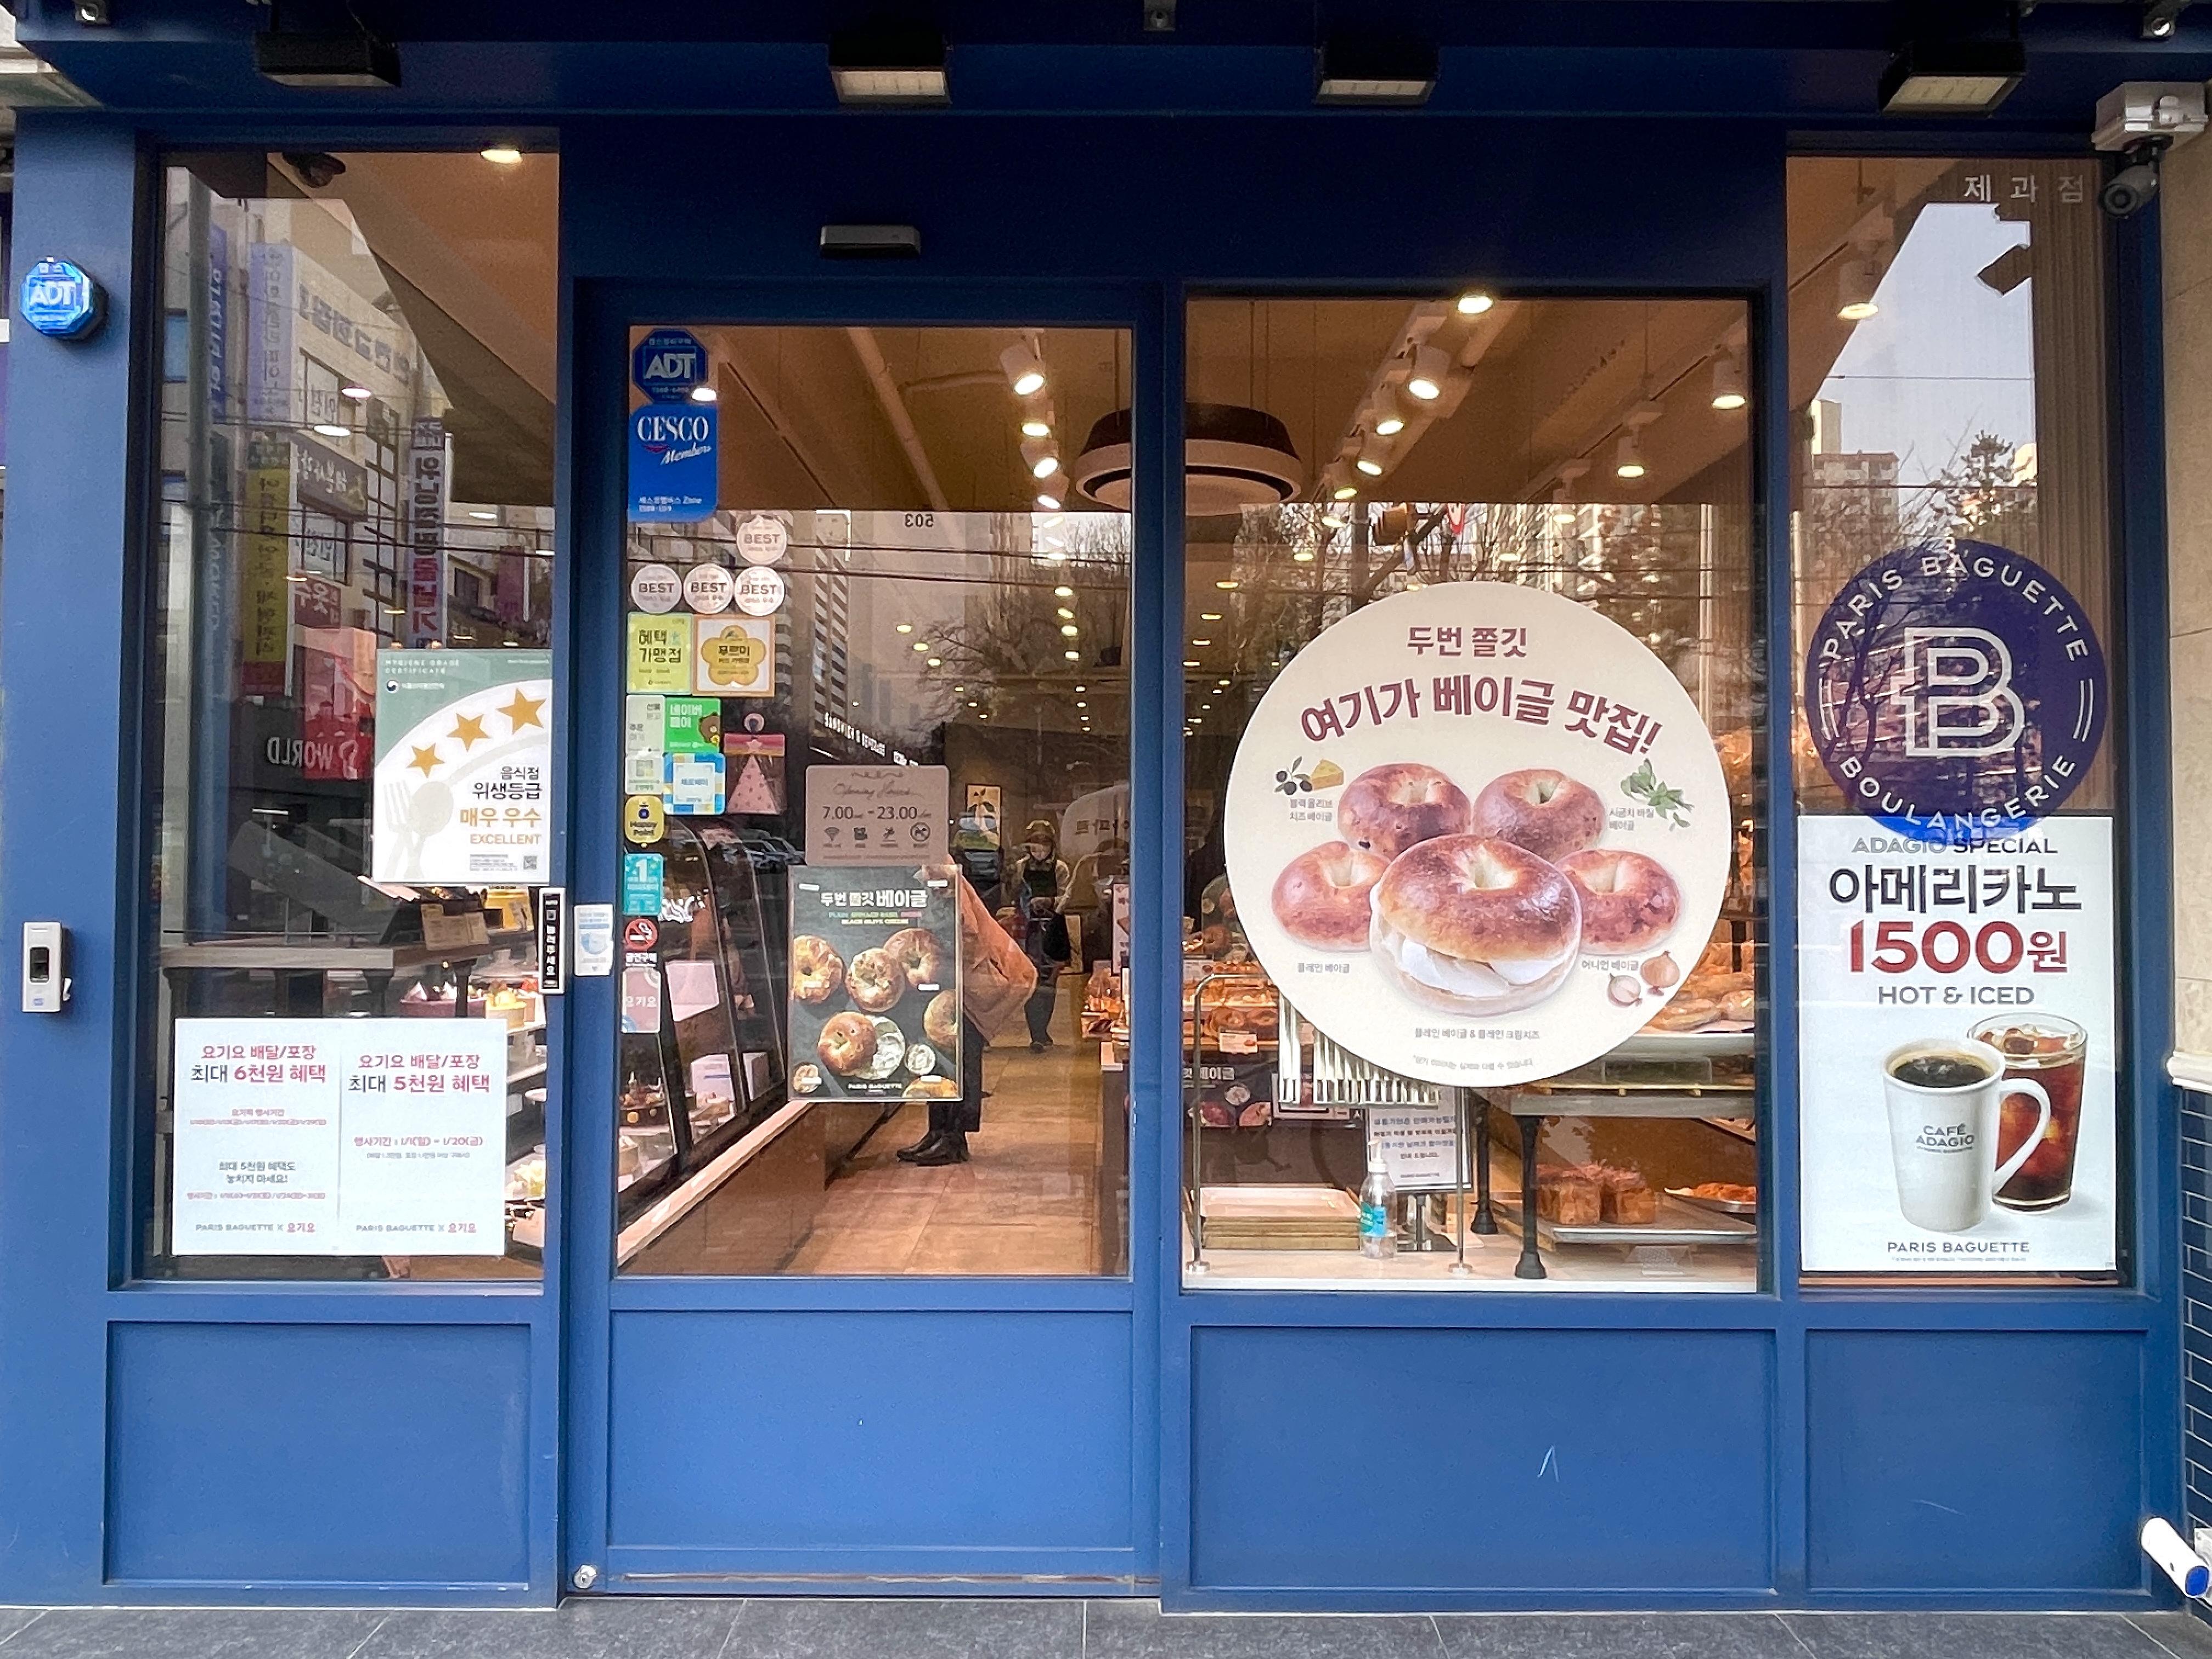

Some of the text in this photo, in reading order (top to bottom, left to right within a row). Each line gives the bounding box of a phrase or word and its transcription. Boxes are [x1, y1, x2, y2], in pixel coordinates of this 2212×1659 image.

[1963, 174, 2084, 203] 제과점
[30, 281, 76, 306] ADT
[644, 353, 696, 379] ADT
[637, 416, 709, 441] CESCO
[744, 534, 780, 544] BEST
[639, 583, 675, 593] BEST
[690, 582, 727, 592] BEST
[741, 585, 777, 595] BEST
[1823, 569, 1902, 661] PARIS
[1921, 554, 2089, 662] BAGUETTE
[1408, 626, 1526, 657] 두번 쫄깃
[639, 648, 681, 663] 가맹점
[1301, 675, 1662, 755] 여기가 베이글 맛집!
[500, 766, 540, 780] 음식점
[472, 782, 543, 800] 위생등급
[1840, 755, 2075, 830] BOULANGERIE
[460, 808, 542, 827] 매우 우수
[1307, 812, 1333, 821] 베이글
[1609, 821, 1634, 831] 베이글
[470, 834, 542, 844] EXCELLENT
[1852, 838, 2058, 854] ADAGIO SPECIAL
[1829, 865, 2082, 914] 아메리카노
[821, 891, 847, 906] 두번
[876, 889, 928, 907] 베이글
[1850, 920, 2067, 973] 1500원
[1324, 963, 1350, 973] 베이글
[1582, 960, 1639, 970] 어니언 베이글
[1878, 986, 2034, 1005] HOT & ICED
[201, 1045, 317, 1060] 요기요 배달/포장
[358, 1054, 480, 1069] 요기요 배달/포장
[190, 1064, 326, 1084] 최대 6천원 혜택
[348, 1074, 490, 1093] 최대 5천원 혜택
[1923, 1123, 1966, 1136] CAFÉ
[354, 1137, 391, 1146] 행사기간
[1916, 1135, 1975, 1147] ADAGIO
[195, 1223, 224, 1232] PARIS
[225, 1223, 274, 1232] BAGUETTE
[287, 1222, 315, 1233] 요기요
[448, 1223, 476, 1233] 요기요
[1887, 1242, 2030, 1253] PARIS BAGUETTE
